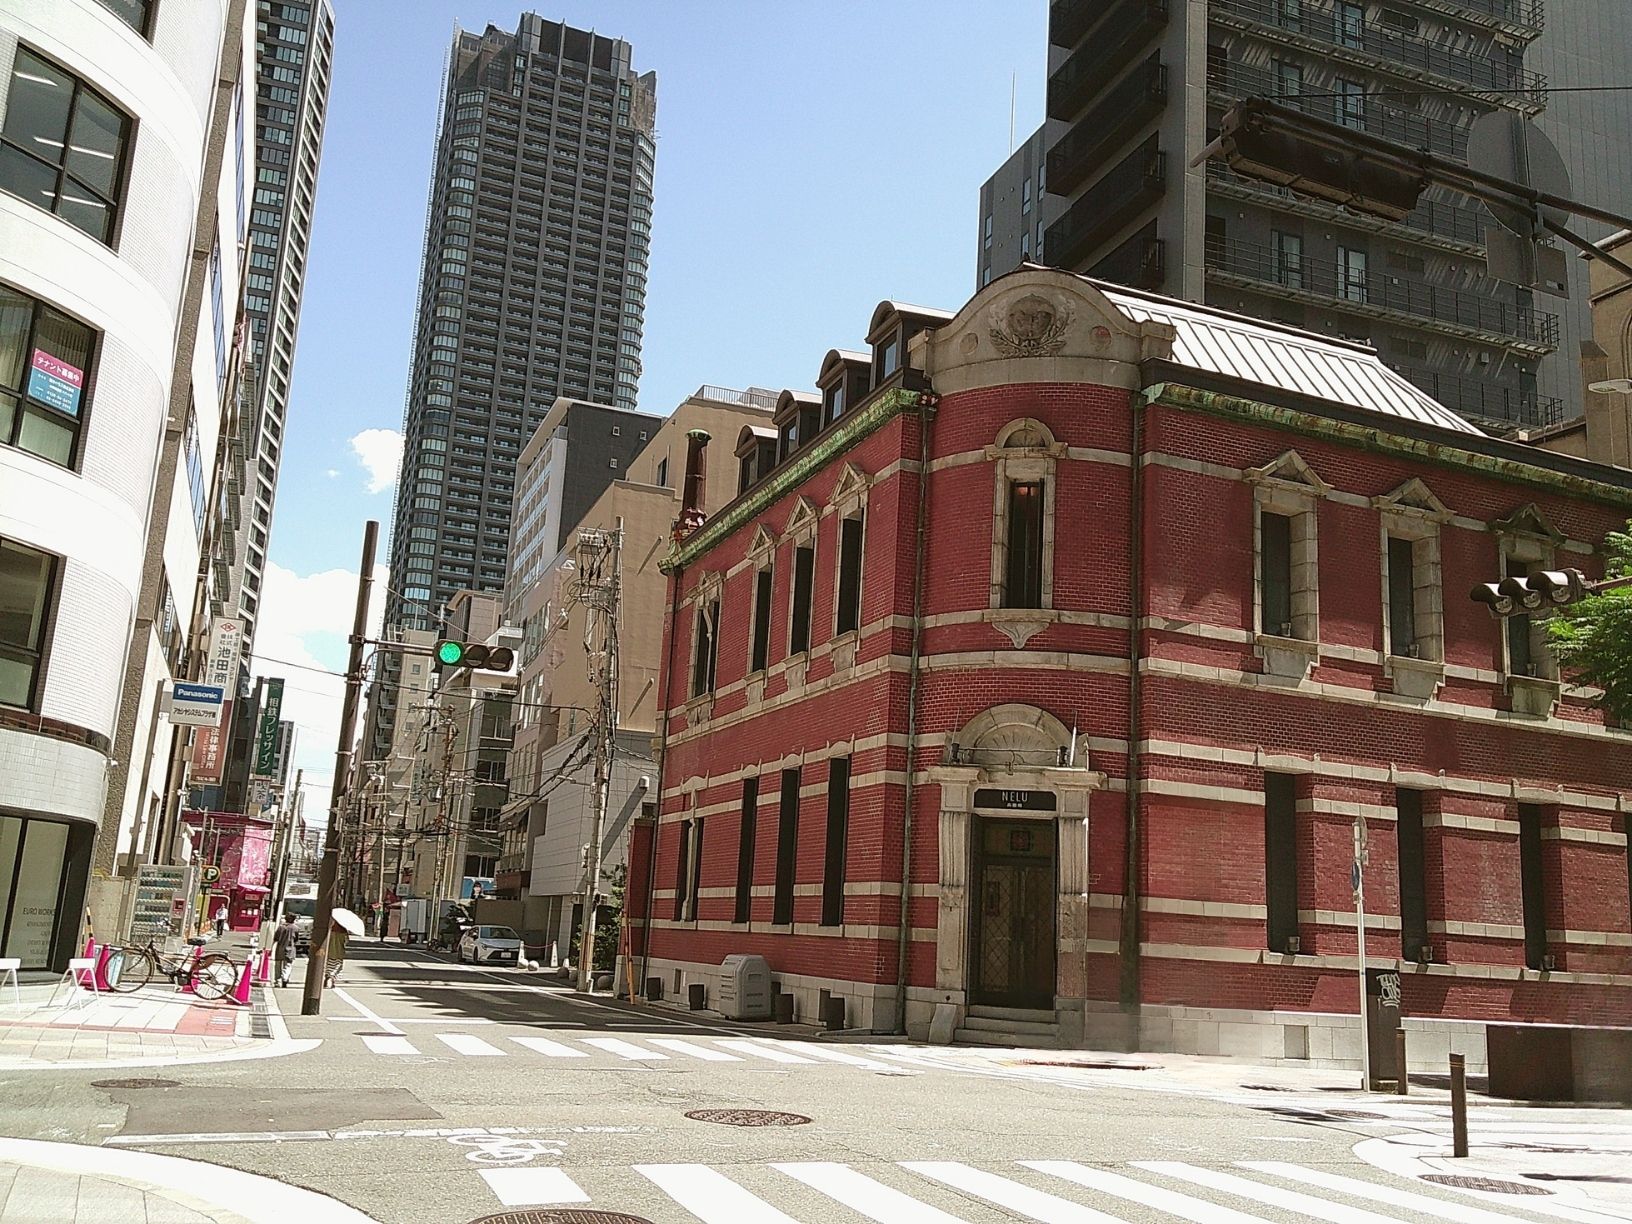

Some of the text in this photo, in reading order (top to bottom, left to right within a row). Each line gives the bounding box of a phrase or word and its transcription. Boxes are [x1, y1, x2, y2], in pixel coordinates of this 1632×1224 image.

[212, 646, 231, 687] 池田商
[177, 688, 219, 699] Panasonic
[259, 697, 280, 770] 相鉄フレッサイン
[1001, 791, 1028, 802] NELU
[206, 868, 218, 880] P
